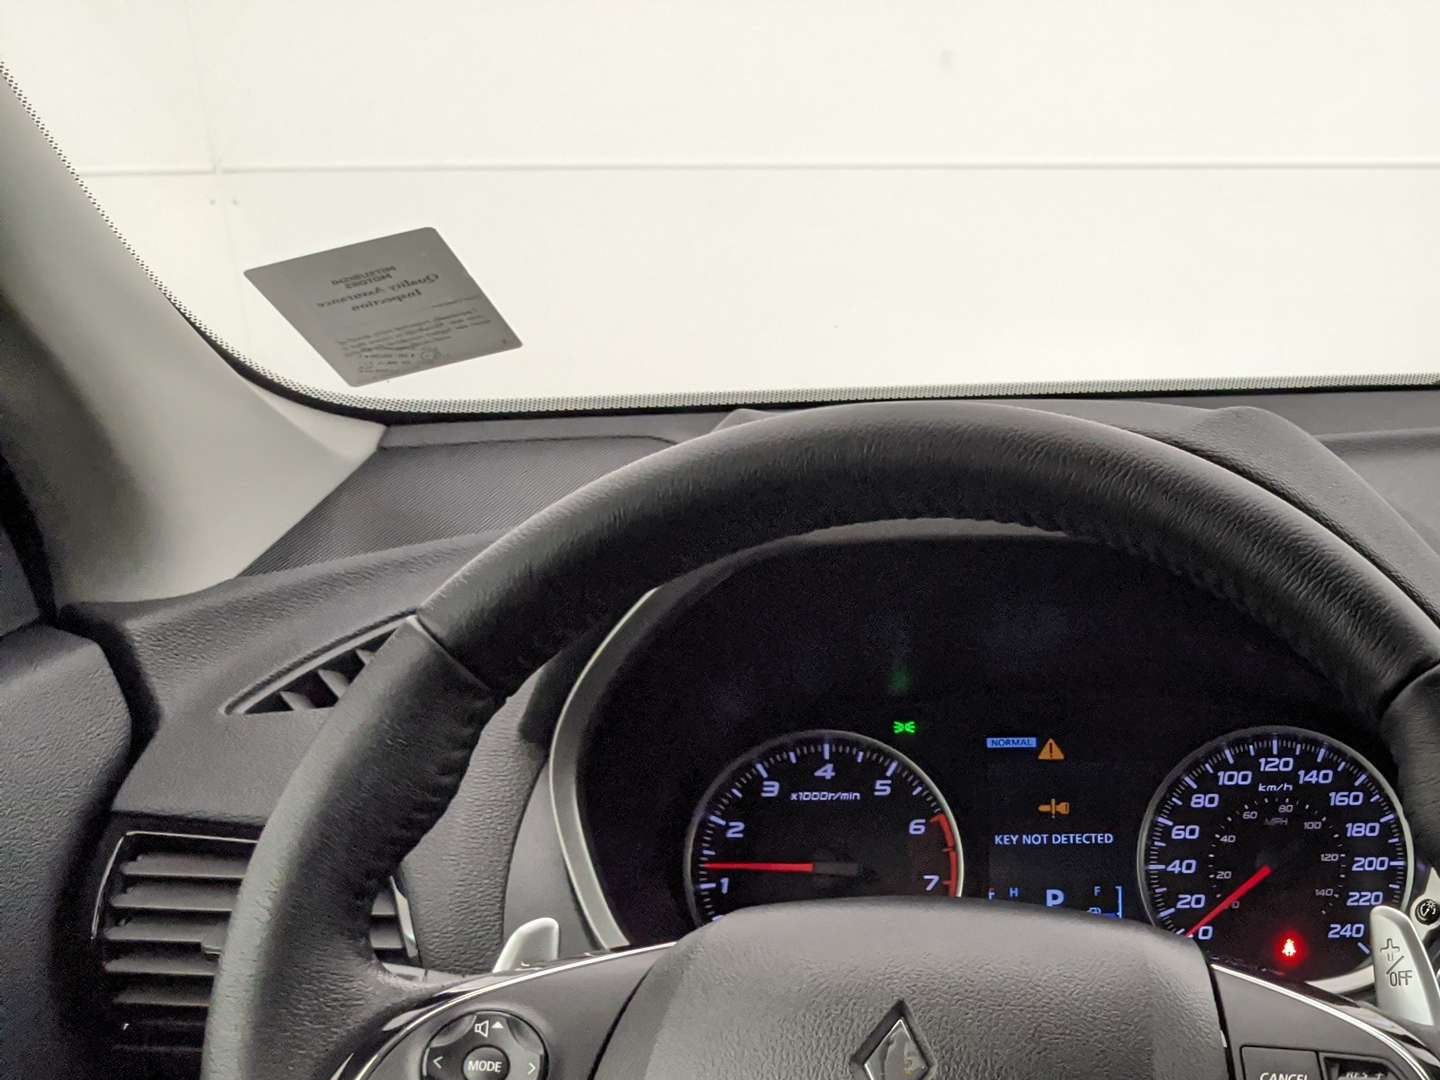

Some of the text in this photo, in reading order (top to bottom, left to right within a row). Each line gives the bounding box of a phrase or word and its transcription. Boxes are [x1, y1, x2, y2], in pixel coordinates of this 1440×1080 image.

[991, 738, 1033, 747] NORMAL
[814, 763, 836, 780] 4
[1258, 757, 1294, 772] 120
[1217, 770, 1253, 786] 100
[1298, 769, 1333, 785] 140
[761, 780, 781, 798] 3
[873, 779, 893, 796] 5
[1258, 781, 1293, 793] km/h
[790, 791, 861, 802] x1000r/min
[1190, 793, 1219, 808] 80
[1328, 791, 1364, 807] 160
[1242, 810, 1258, 820] 60
[1278, 804, 1294, 814] 80
[725, 821, 745, 838] 2
[908, 818, 927, 836] 6
[1171, 824, 1200, 840] 60
[1303, 821, 1322, 830] 100
[1345, 822, 1380, 837] 180
[994, 832, 1114, 846] KEY NOT DETECTED
[1219, 834, 1237, 843] 40
[1320, 853, 1340, 862] 120
[1352, 856, 1389, 871] 200
[1166, 859, 1197, 874] 40
[1215, 870, 1233, 880] 20
[720, 877, 729, 895] 1
[922, 875, 941, 892] 7
[1009, 887, 1019, 897] H
[1045, 889, 1065, 908] P
[1314, 888, 1334, 897] 140
[1346, 891, 1384, 906] 220
[1175, 893, 1206, 909] 20
[1197, 925, 1214, 940] 0
[1327, 923, 1365, 938] 240
[1389, 969, 1413, 987] OFF
[467, 1059, 503, 1074] MODE
